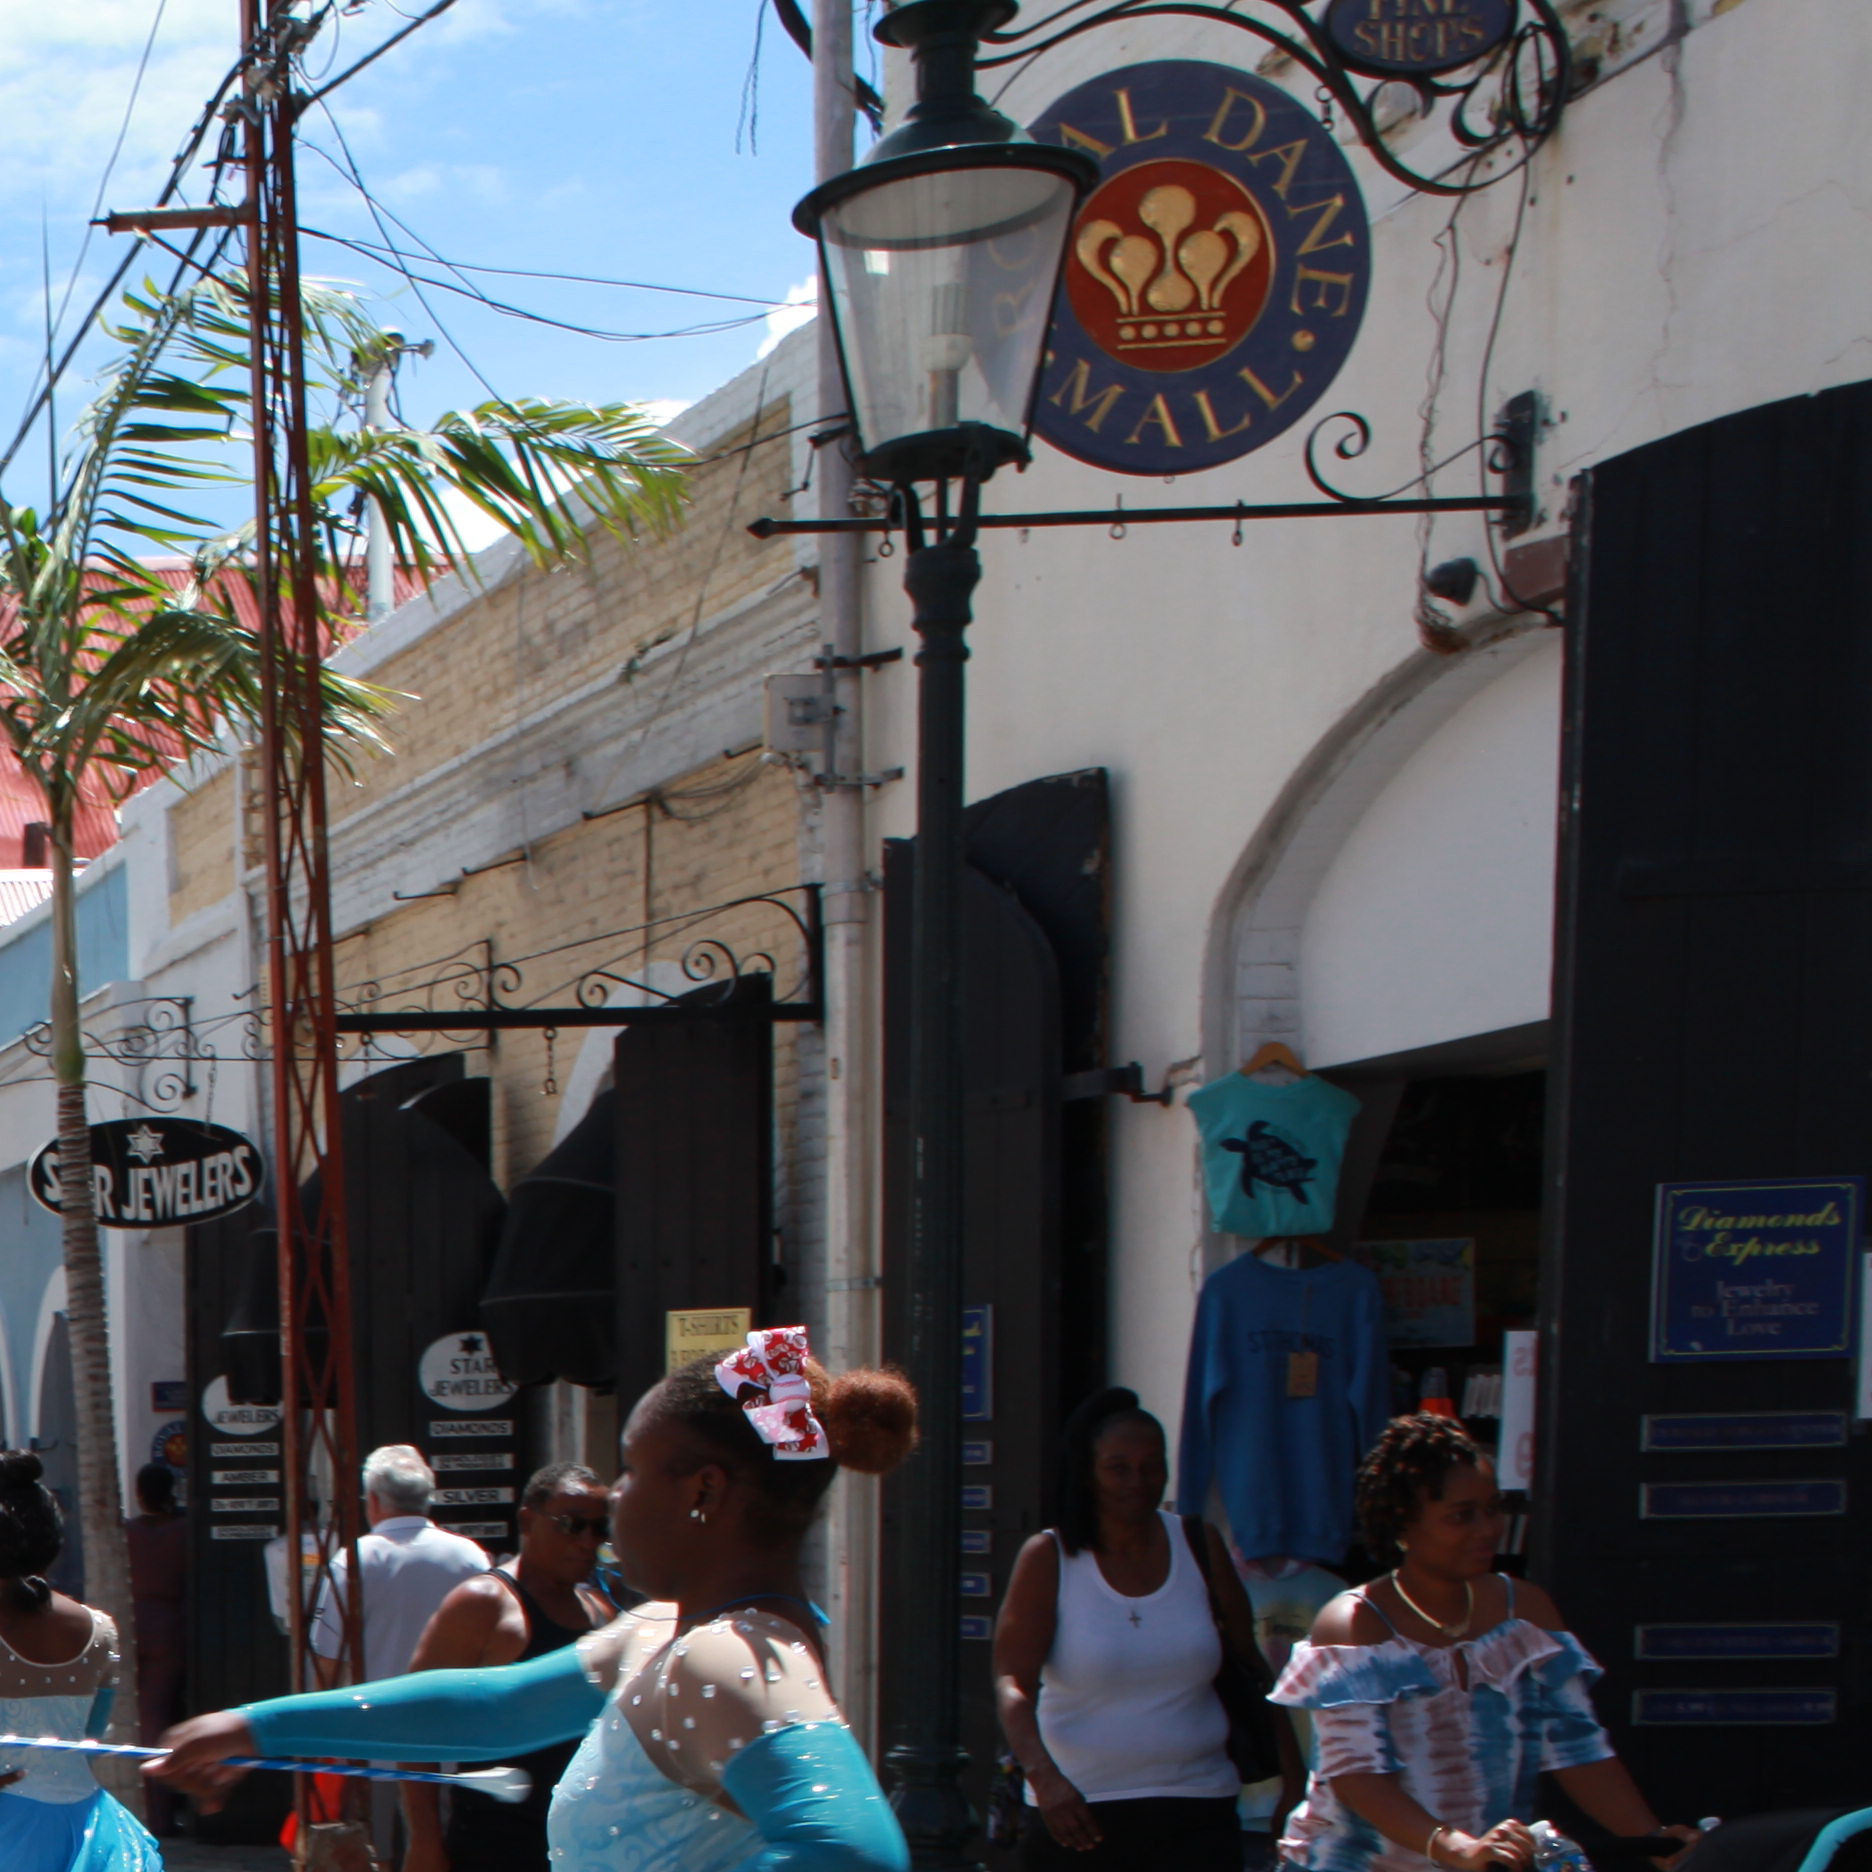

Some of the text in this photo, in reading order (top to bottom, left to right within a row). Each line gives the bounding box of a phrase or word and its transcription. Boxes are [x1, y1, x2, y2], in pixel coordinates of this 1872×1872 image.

[1354, 17, 1484, 61] SHOPS
[1202, 86, 1355, 317] DANE
[1050, 359, 1303, 448] MALL
[42, 1145, 254, 1221] SR JEWELERS
[1677, 1202, 1843, 1232] Diamonds
[1705, 1231, 1821, 1266] Express
[1716, 1279, 1796, 1301] Jewelry
[1722, 1299, 1821, 1318] Enhance
[1726, 1318, 1783, 1336] Love
[450, 1358, 497, 1374] STAR
[429, 1379, 518, 1397] JEWELERS
[433, 1422, 509, 1435] DIAMONDS
[443, 1489, 500, 1504] SILVER
